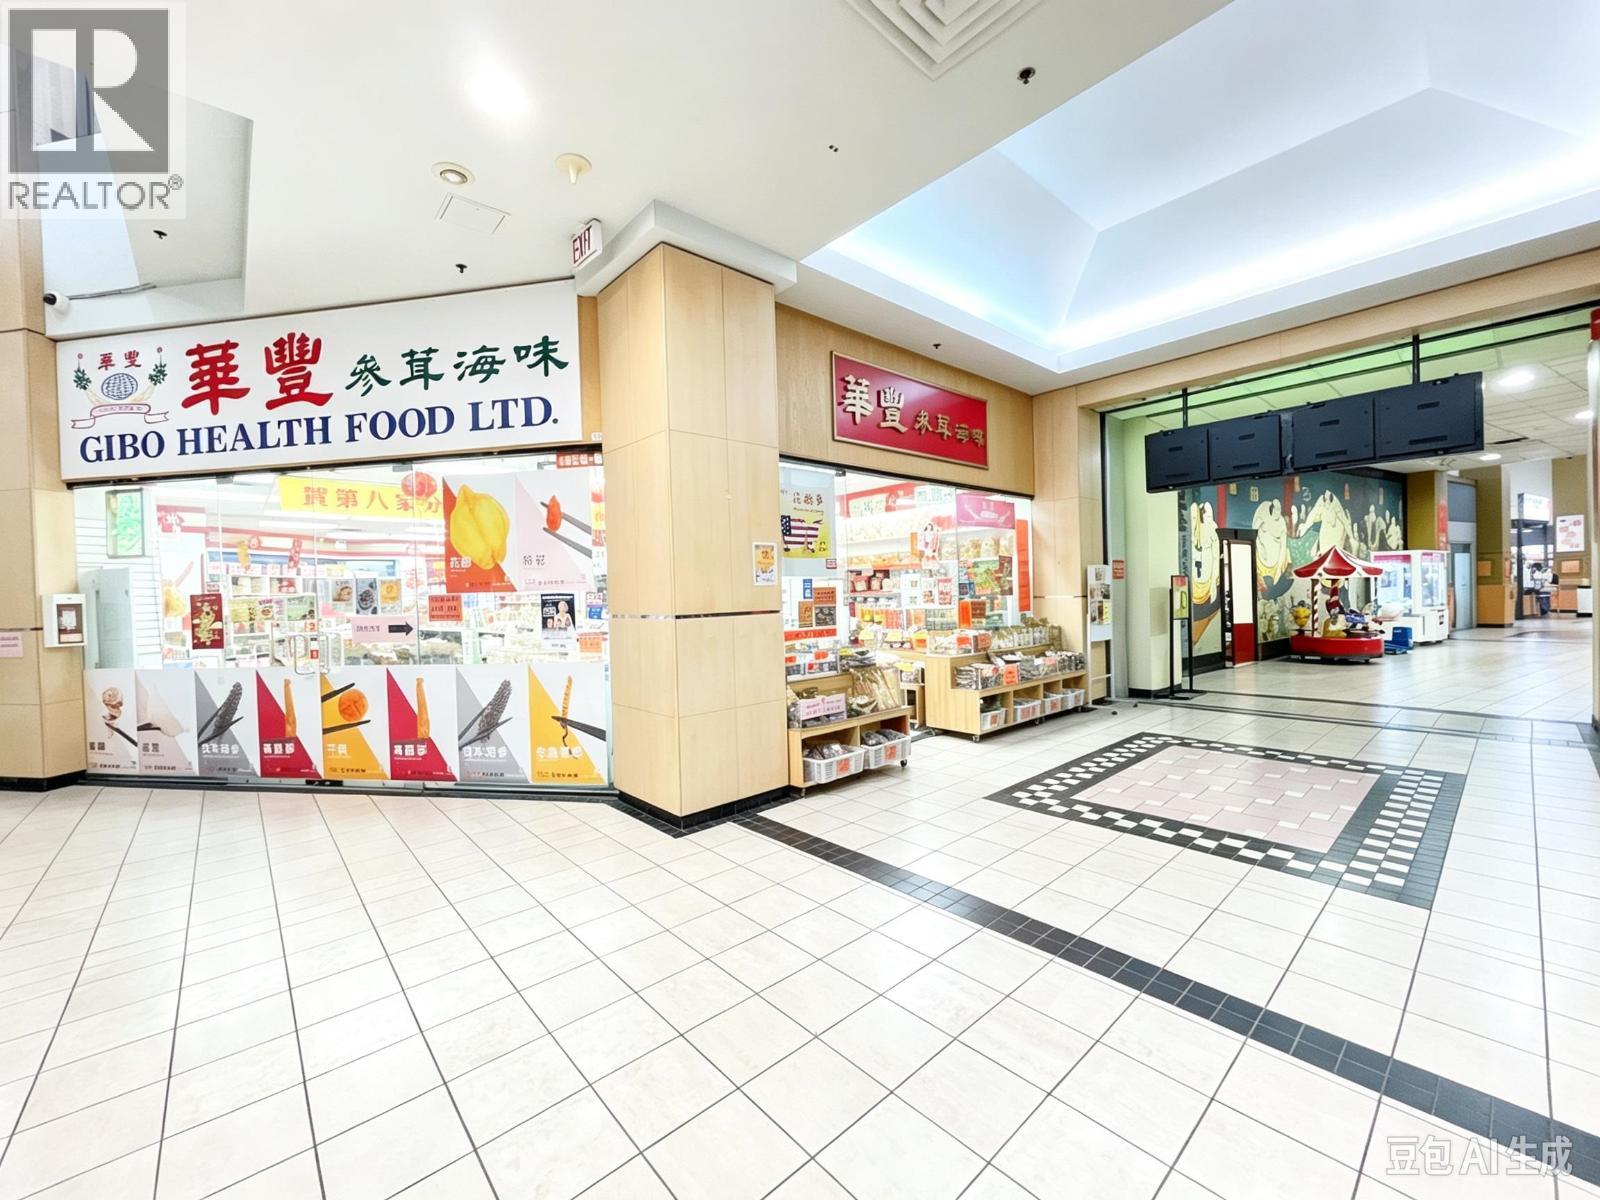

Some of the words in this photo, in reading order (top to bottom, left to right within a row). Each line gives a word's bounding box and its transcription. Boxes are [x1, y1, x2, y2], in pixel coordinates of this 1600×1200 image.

[572, 225, 592, 264] EXIT
[181, 332, 334, 416] 華豐
[345, 335, 569, 397] 參茸海味
[842, 374, 909, 434] 華豐
[79, 430, 166, 463] GIBO
[176, 415, 332, 456] HEALTH
[344, 405, 455, 443] FOOD
[467, 396, 559, 432] LTD.
